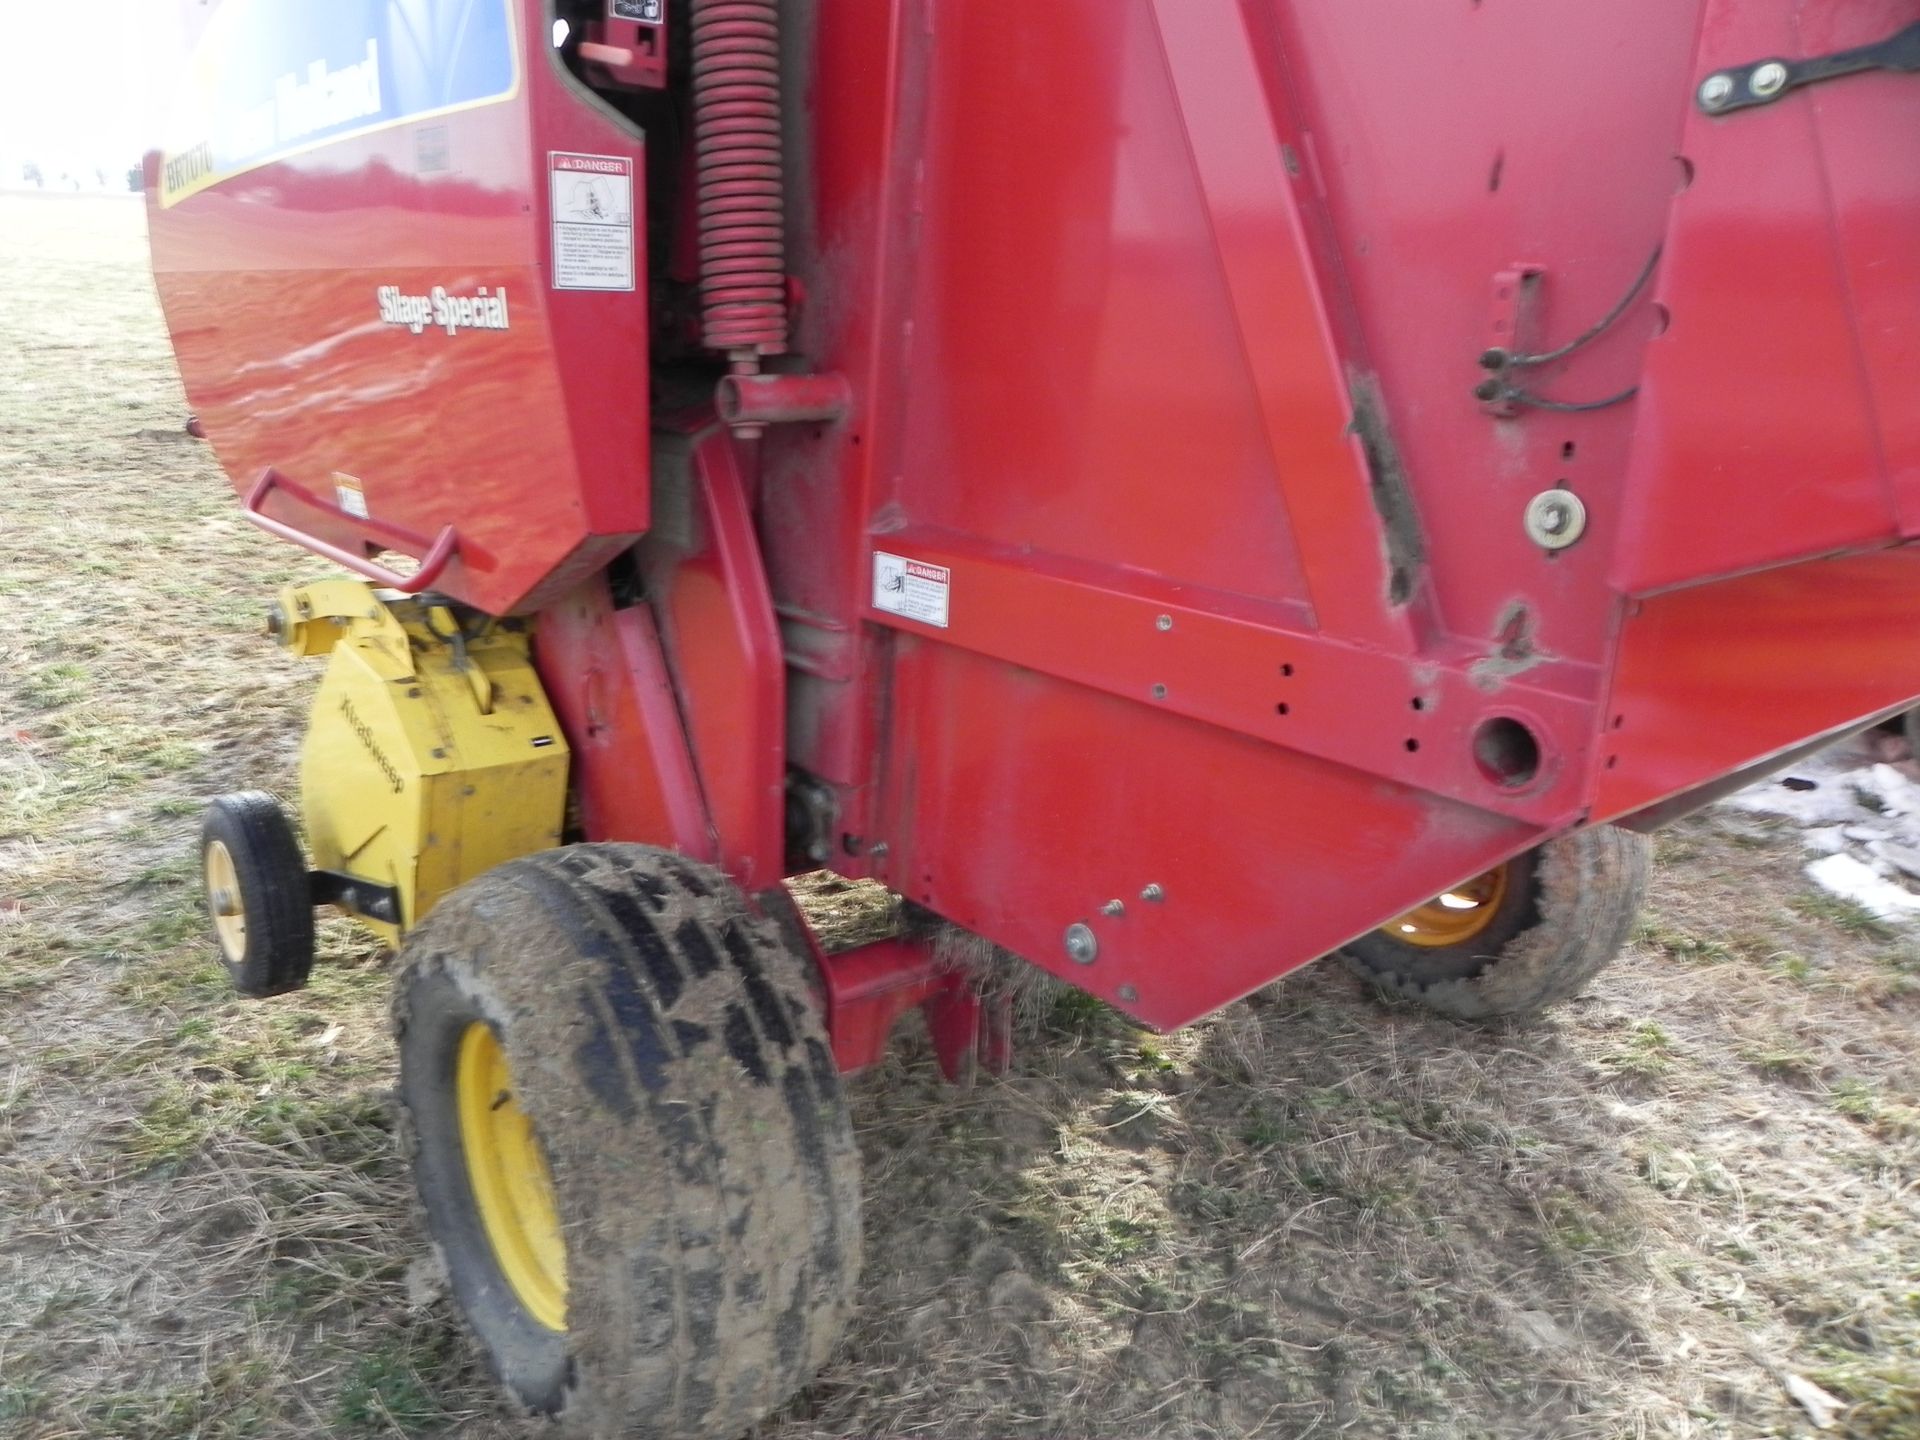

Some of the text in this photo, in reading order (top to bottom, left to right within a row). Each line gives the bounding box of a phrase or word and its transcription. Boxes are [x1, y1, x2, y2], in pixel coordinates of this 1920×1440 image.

[575, 159, 624, 173] DANGER
[431, 285, 509, 336] Special
[916, 564, 947, 581] DANGER
